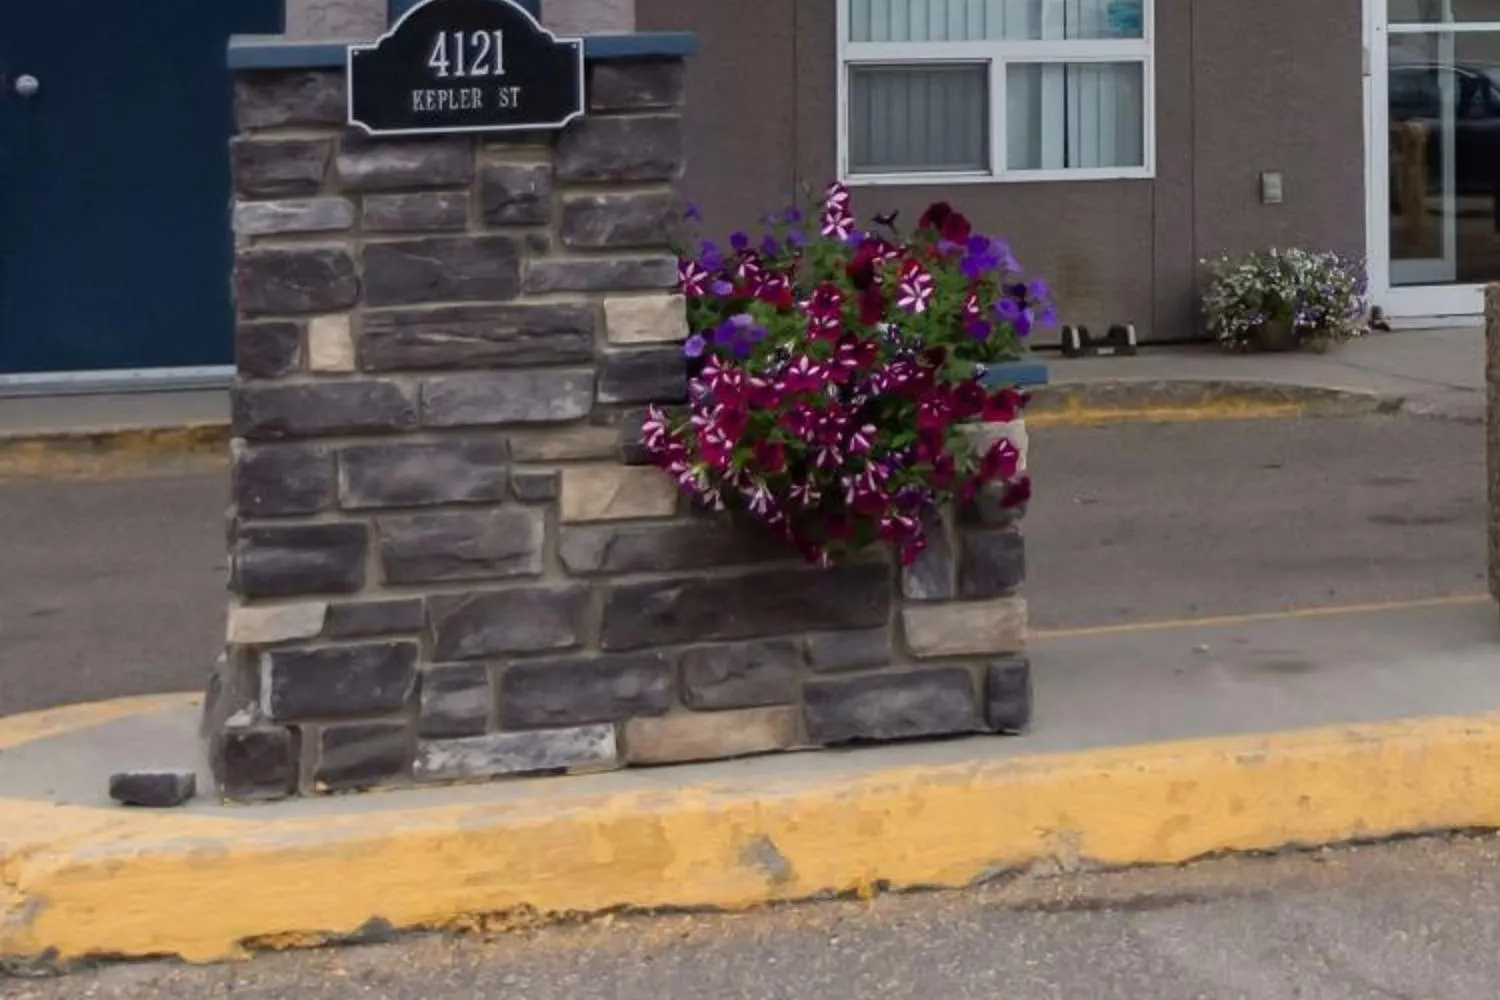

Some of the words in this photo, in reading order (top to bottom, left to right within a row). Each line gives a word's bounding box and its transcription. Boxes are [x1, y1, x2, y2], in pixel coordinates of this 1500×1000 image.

[427, 29, 506, 78] 4121
[412, 87, 483, 112] KEPLER
[498, 86, 521, 108] ST
